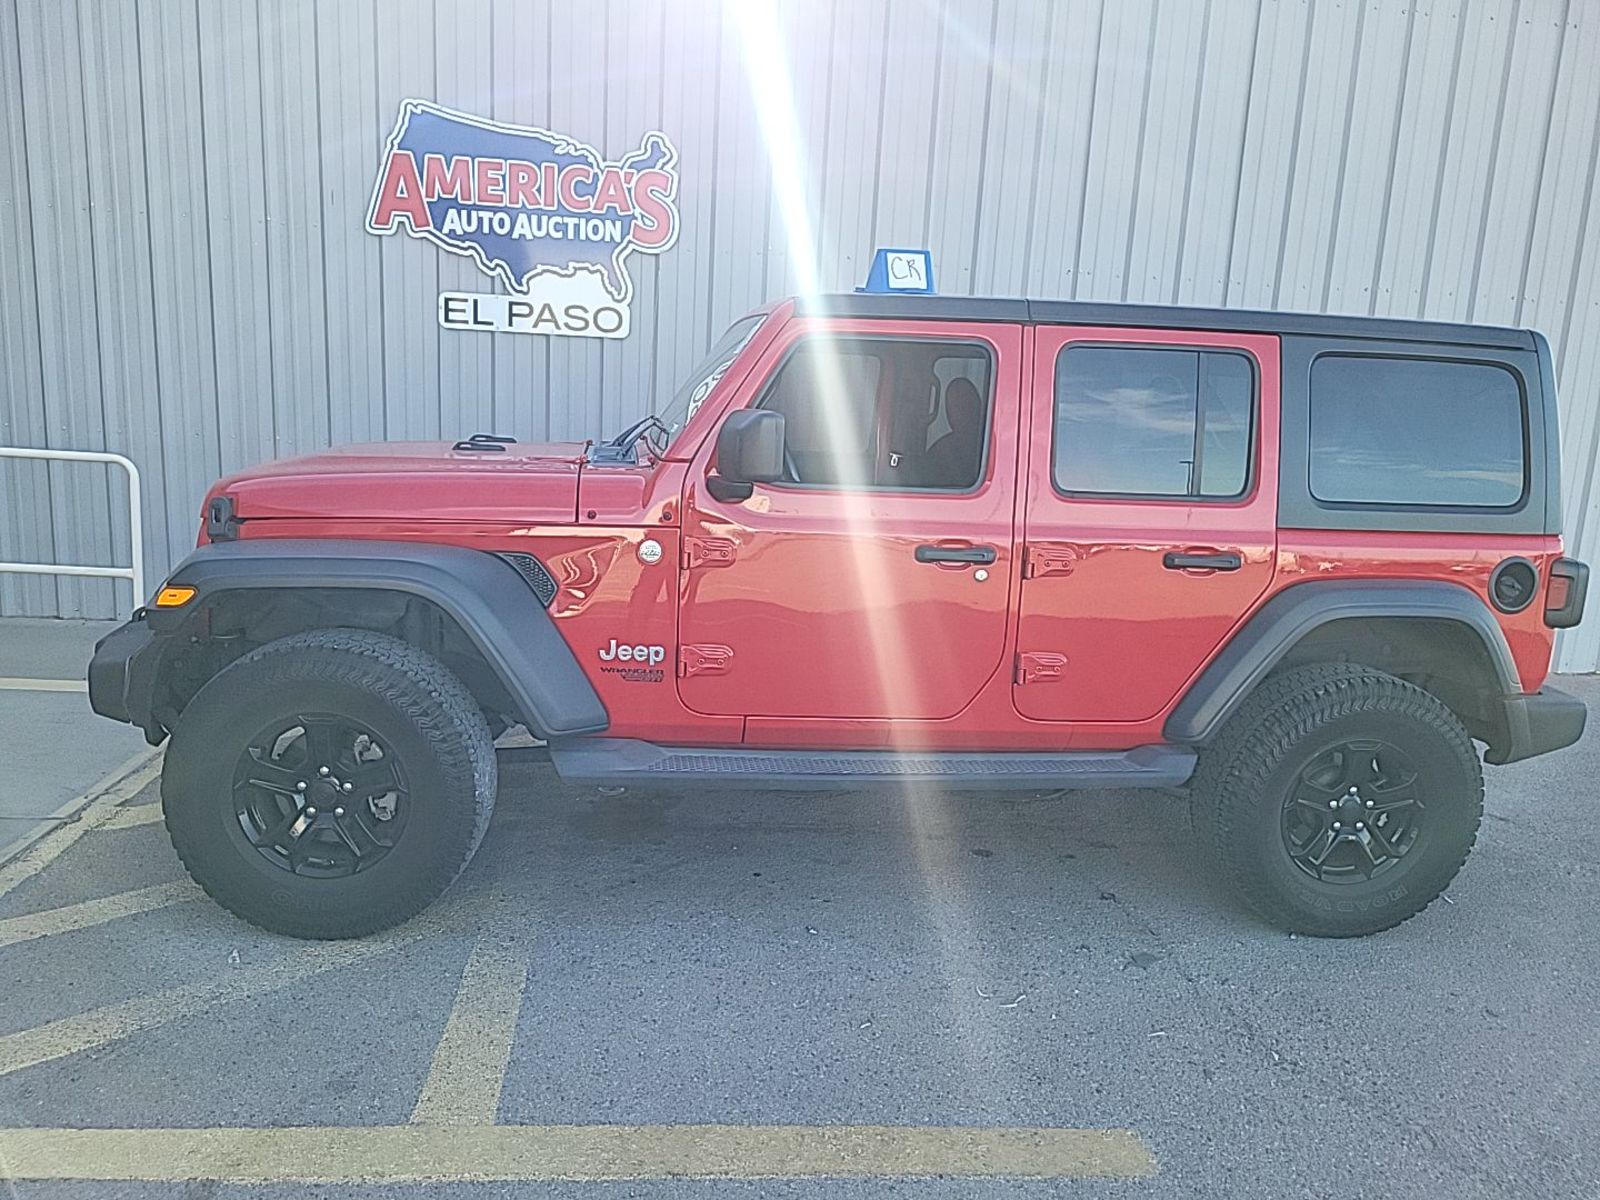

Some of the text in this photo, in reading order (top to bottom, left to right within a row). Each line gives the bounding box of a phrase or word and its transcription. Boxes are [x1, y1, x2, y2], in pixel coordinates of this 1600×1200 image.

[372, 151, 671, 246] AMERICA'S
[442, 208, 622, 242] AUTO AUCTION
[443, 297, 624, 333] EL PASO
[599, 639, 665, 666] Jeep
